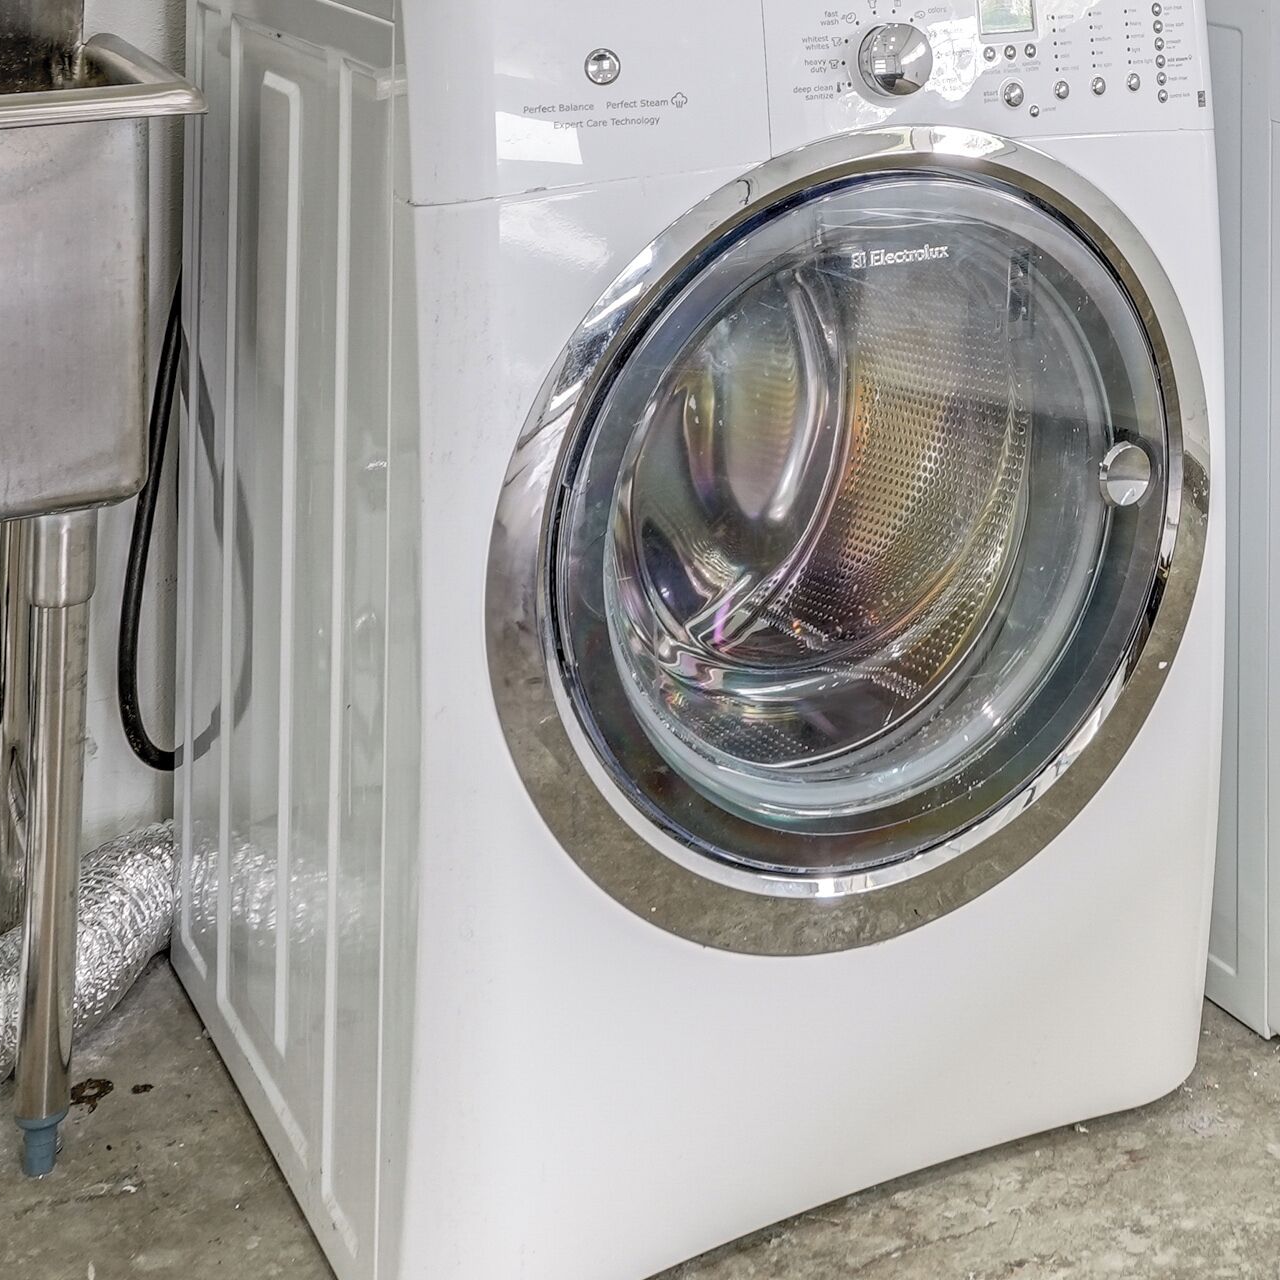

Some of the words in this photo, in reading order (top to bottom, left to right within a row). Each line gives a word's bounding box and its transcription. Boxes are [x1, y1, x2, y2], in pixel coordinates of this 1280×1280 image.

[824, 11, 839, 19] fast
[820, 18, 839, 27] wash
[801, 35, 829, 44] whitest
[805, 42, 830, 51] whites
[804, 59, 826, 67] heavy
[810, 66, 827, 74] duty
[793, 87, 812, 95] deep
[814, 84, 833, 92] clean
[805, 92, 834, 101] sanitize
[523, 104, 556, 114] Perfect
[559, 103, 594, 113] Balance
[606, 100, 637, 110] Perfect
[640, 98, 669, 108] Steam
[553, 120, 584, 130] Expert
[586, 118, 608, 128] Care
[610, 115, 661, 126] Technology
[869, 244, 949, 267] Electrolux
